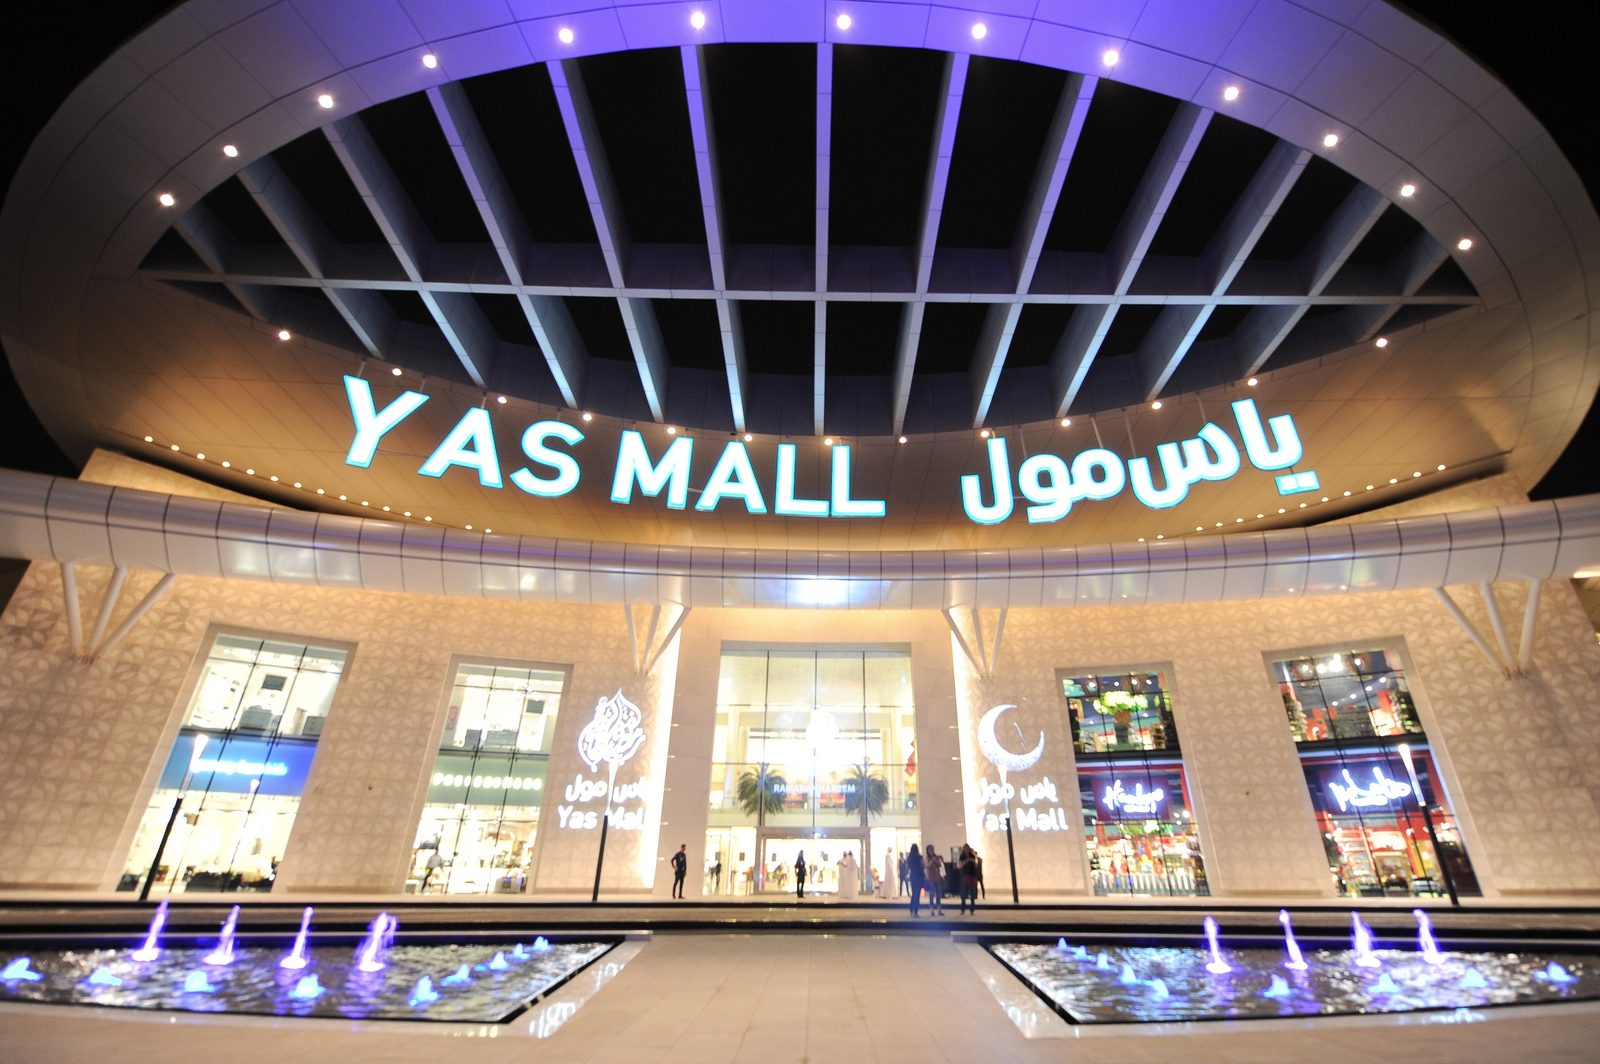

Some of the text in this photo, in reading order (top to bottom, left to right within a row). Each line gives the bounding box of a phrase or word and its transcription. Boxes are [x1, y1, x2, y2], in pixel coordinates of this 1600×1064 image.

[343, 374, 887, 518] YAS MALL
[960, 397, 1321, 526] ياس مول
[565, 773, 608, 802] مول
[612, 776, 657, 804] اس
[557, 805, 652, 831] Yas Mal
[1016, 807, 1069, 831] Mall
